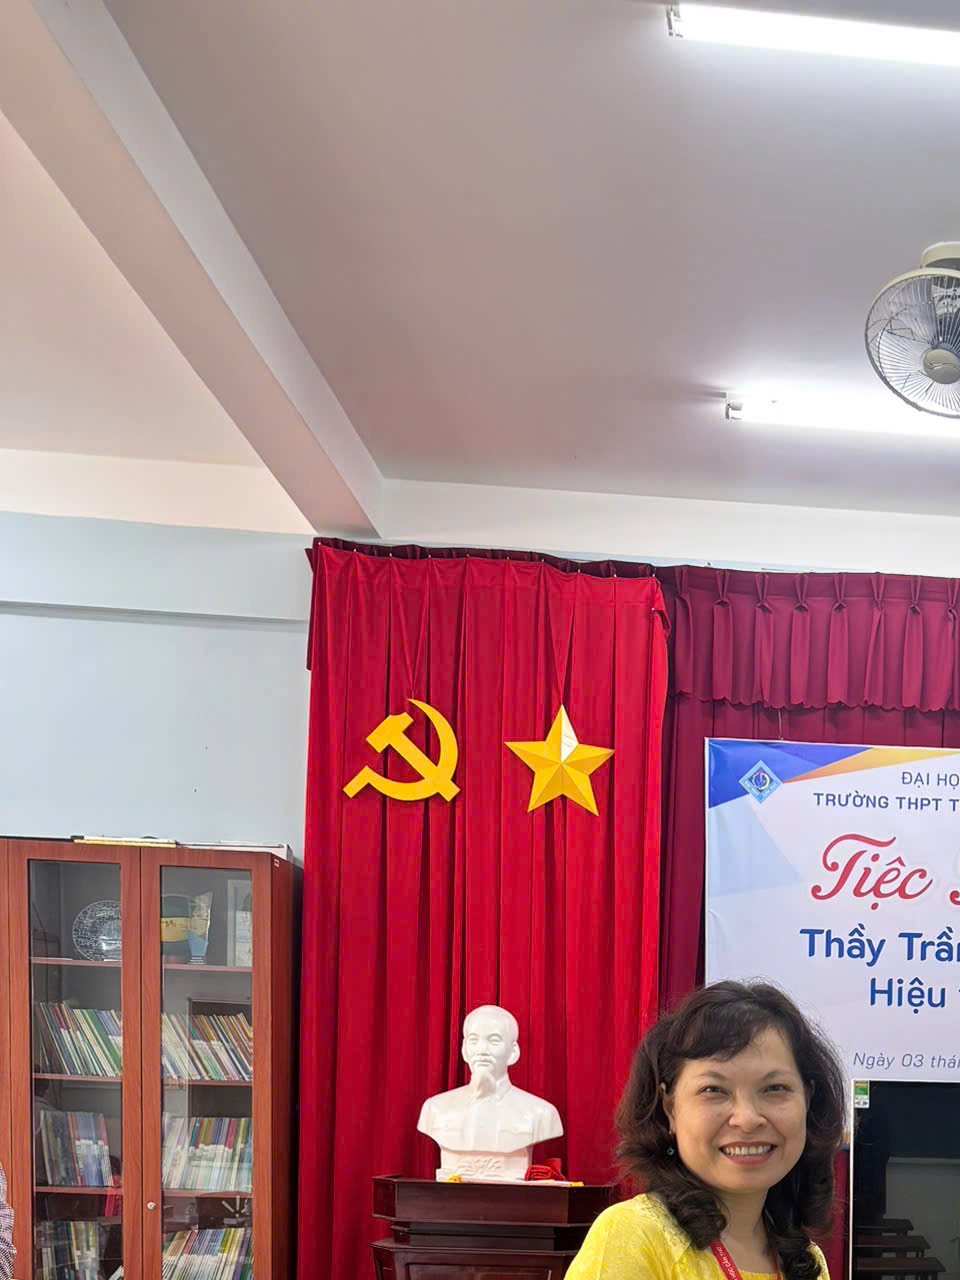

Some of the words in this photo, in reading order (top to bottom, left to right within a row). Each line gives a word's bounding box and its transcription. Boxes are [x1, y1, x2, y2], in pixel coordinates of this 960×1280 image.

[901, 771, 929, 786] ĐẠI
[813, 791, 889, 809] TRƯỜNG
[896, 796, 942, 811] THPT
[811, 833, 933, 911] Tiệc
[800, 923, 886, 967] Thầy
[869, 977, 946, 1015] Hiệu
[853, 1052, 895, 1070] Ngày
[901, 1053, 924, 1068] 03
